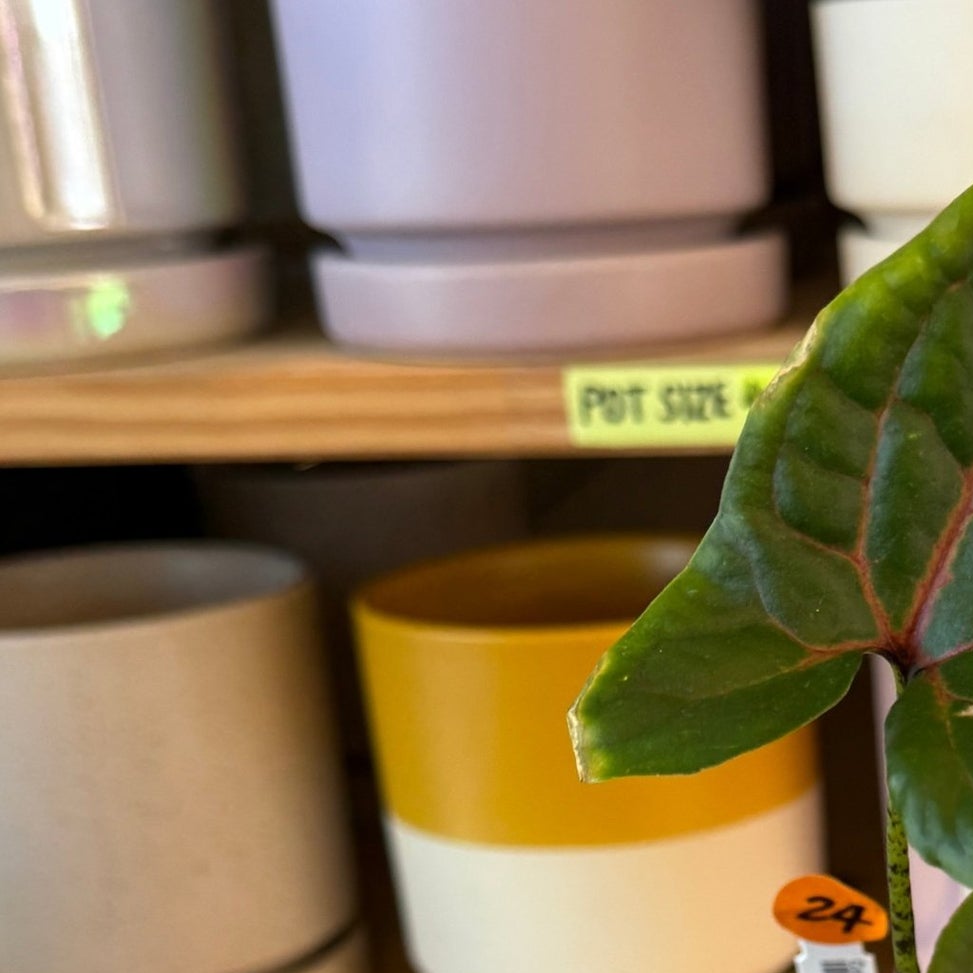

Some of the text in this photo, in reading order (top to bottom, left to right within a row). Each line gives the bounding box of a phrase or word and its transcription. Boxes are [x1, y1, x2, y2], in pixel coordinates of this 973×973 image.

[579, 384, 645, 425] POT
[659, 381, 731, 423] SIZE
[797, 896, 872, 934] 24
